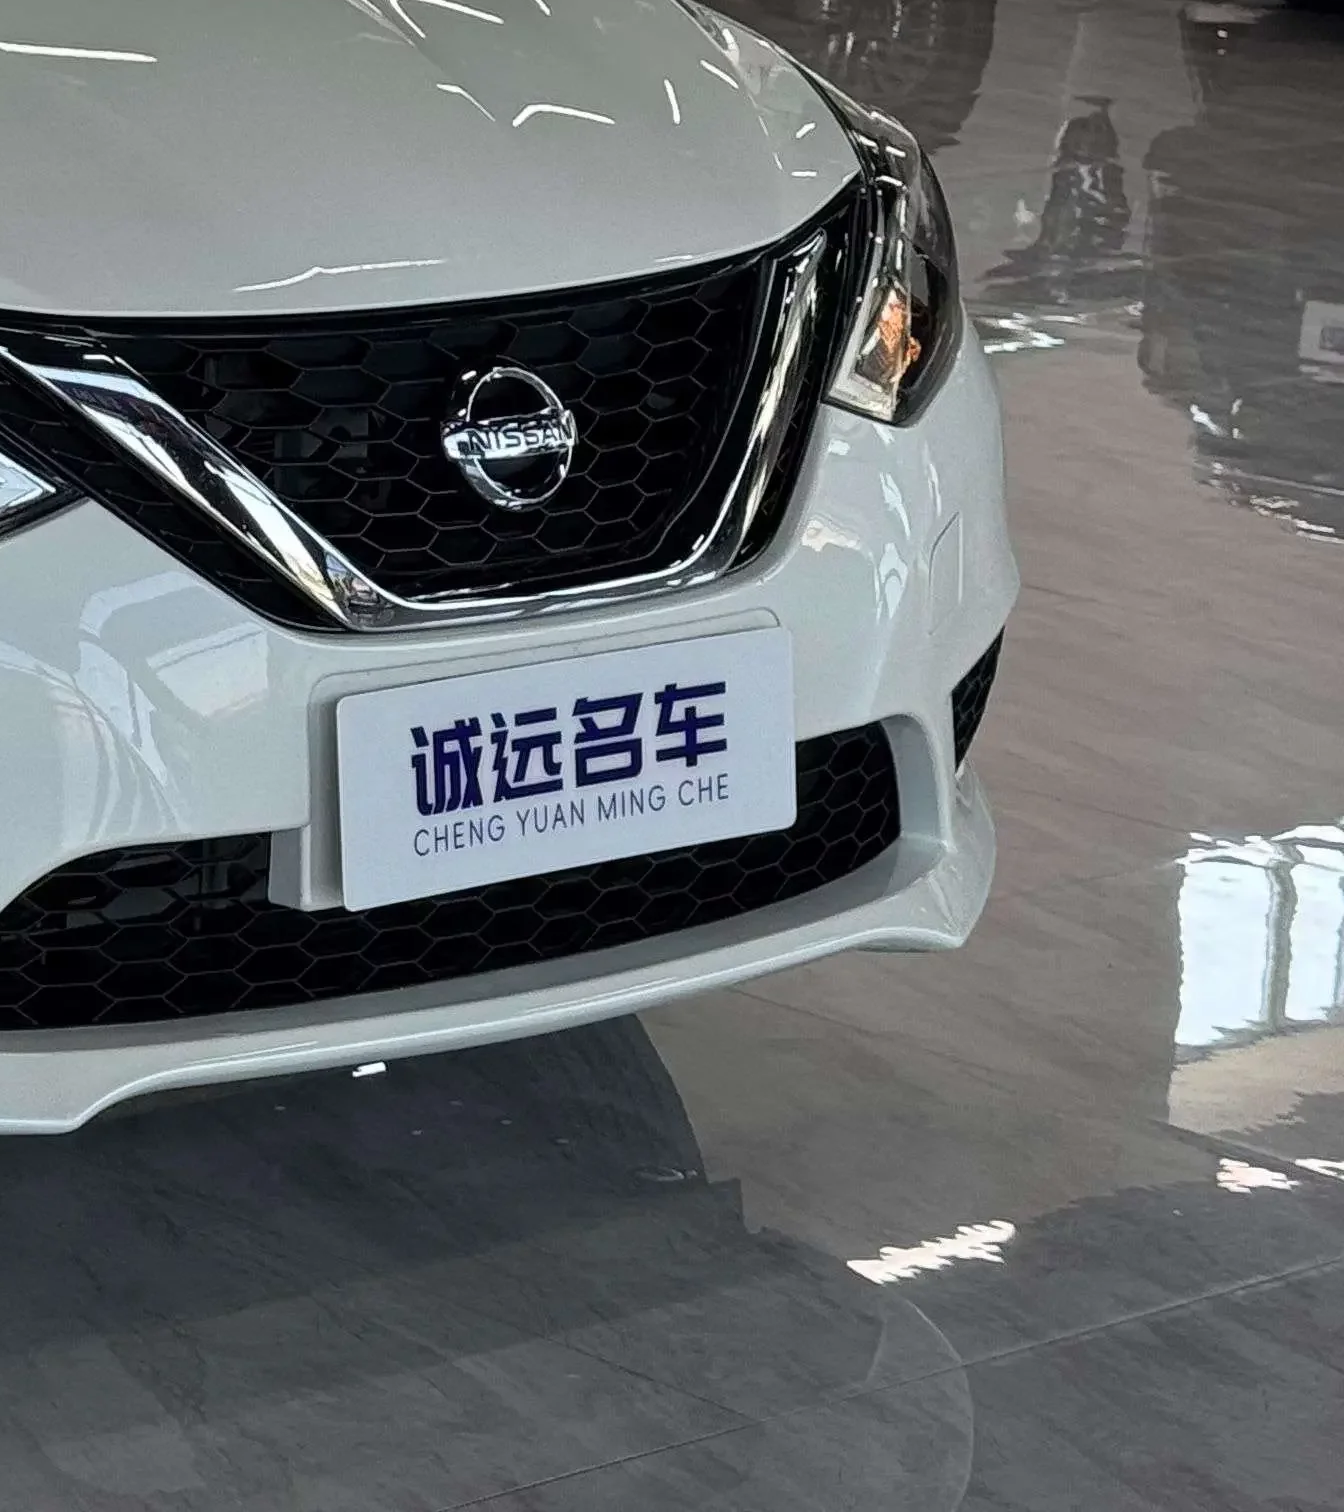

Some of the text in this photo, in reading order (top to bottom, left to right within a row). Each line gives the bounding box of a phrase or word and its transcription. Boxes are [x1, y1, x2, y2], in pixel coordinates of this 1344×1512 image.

[468, 414, 575, 454] NISSAN
[409, 680, 728, 817] 诚远名车
[413, 772, 730, 857] CHENG YUAN MING CHE
